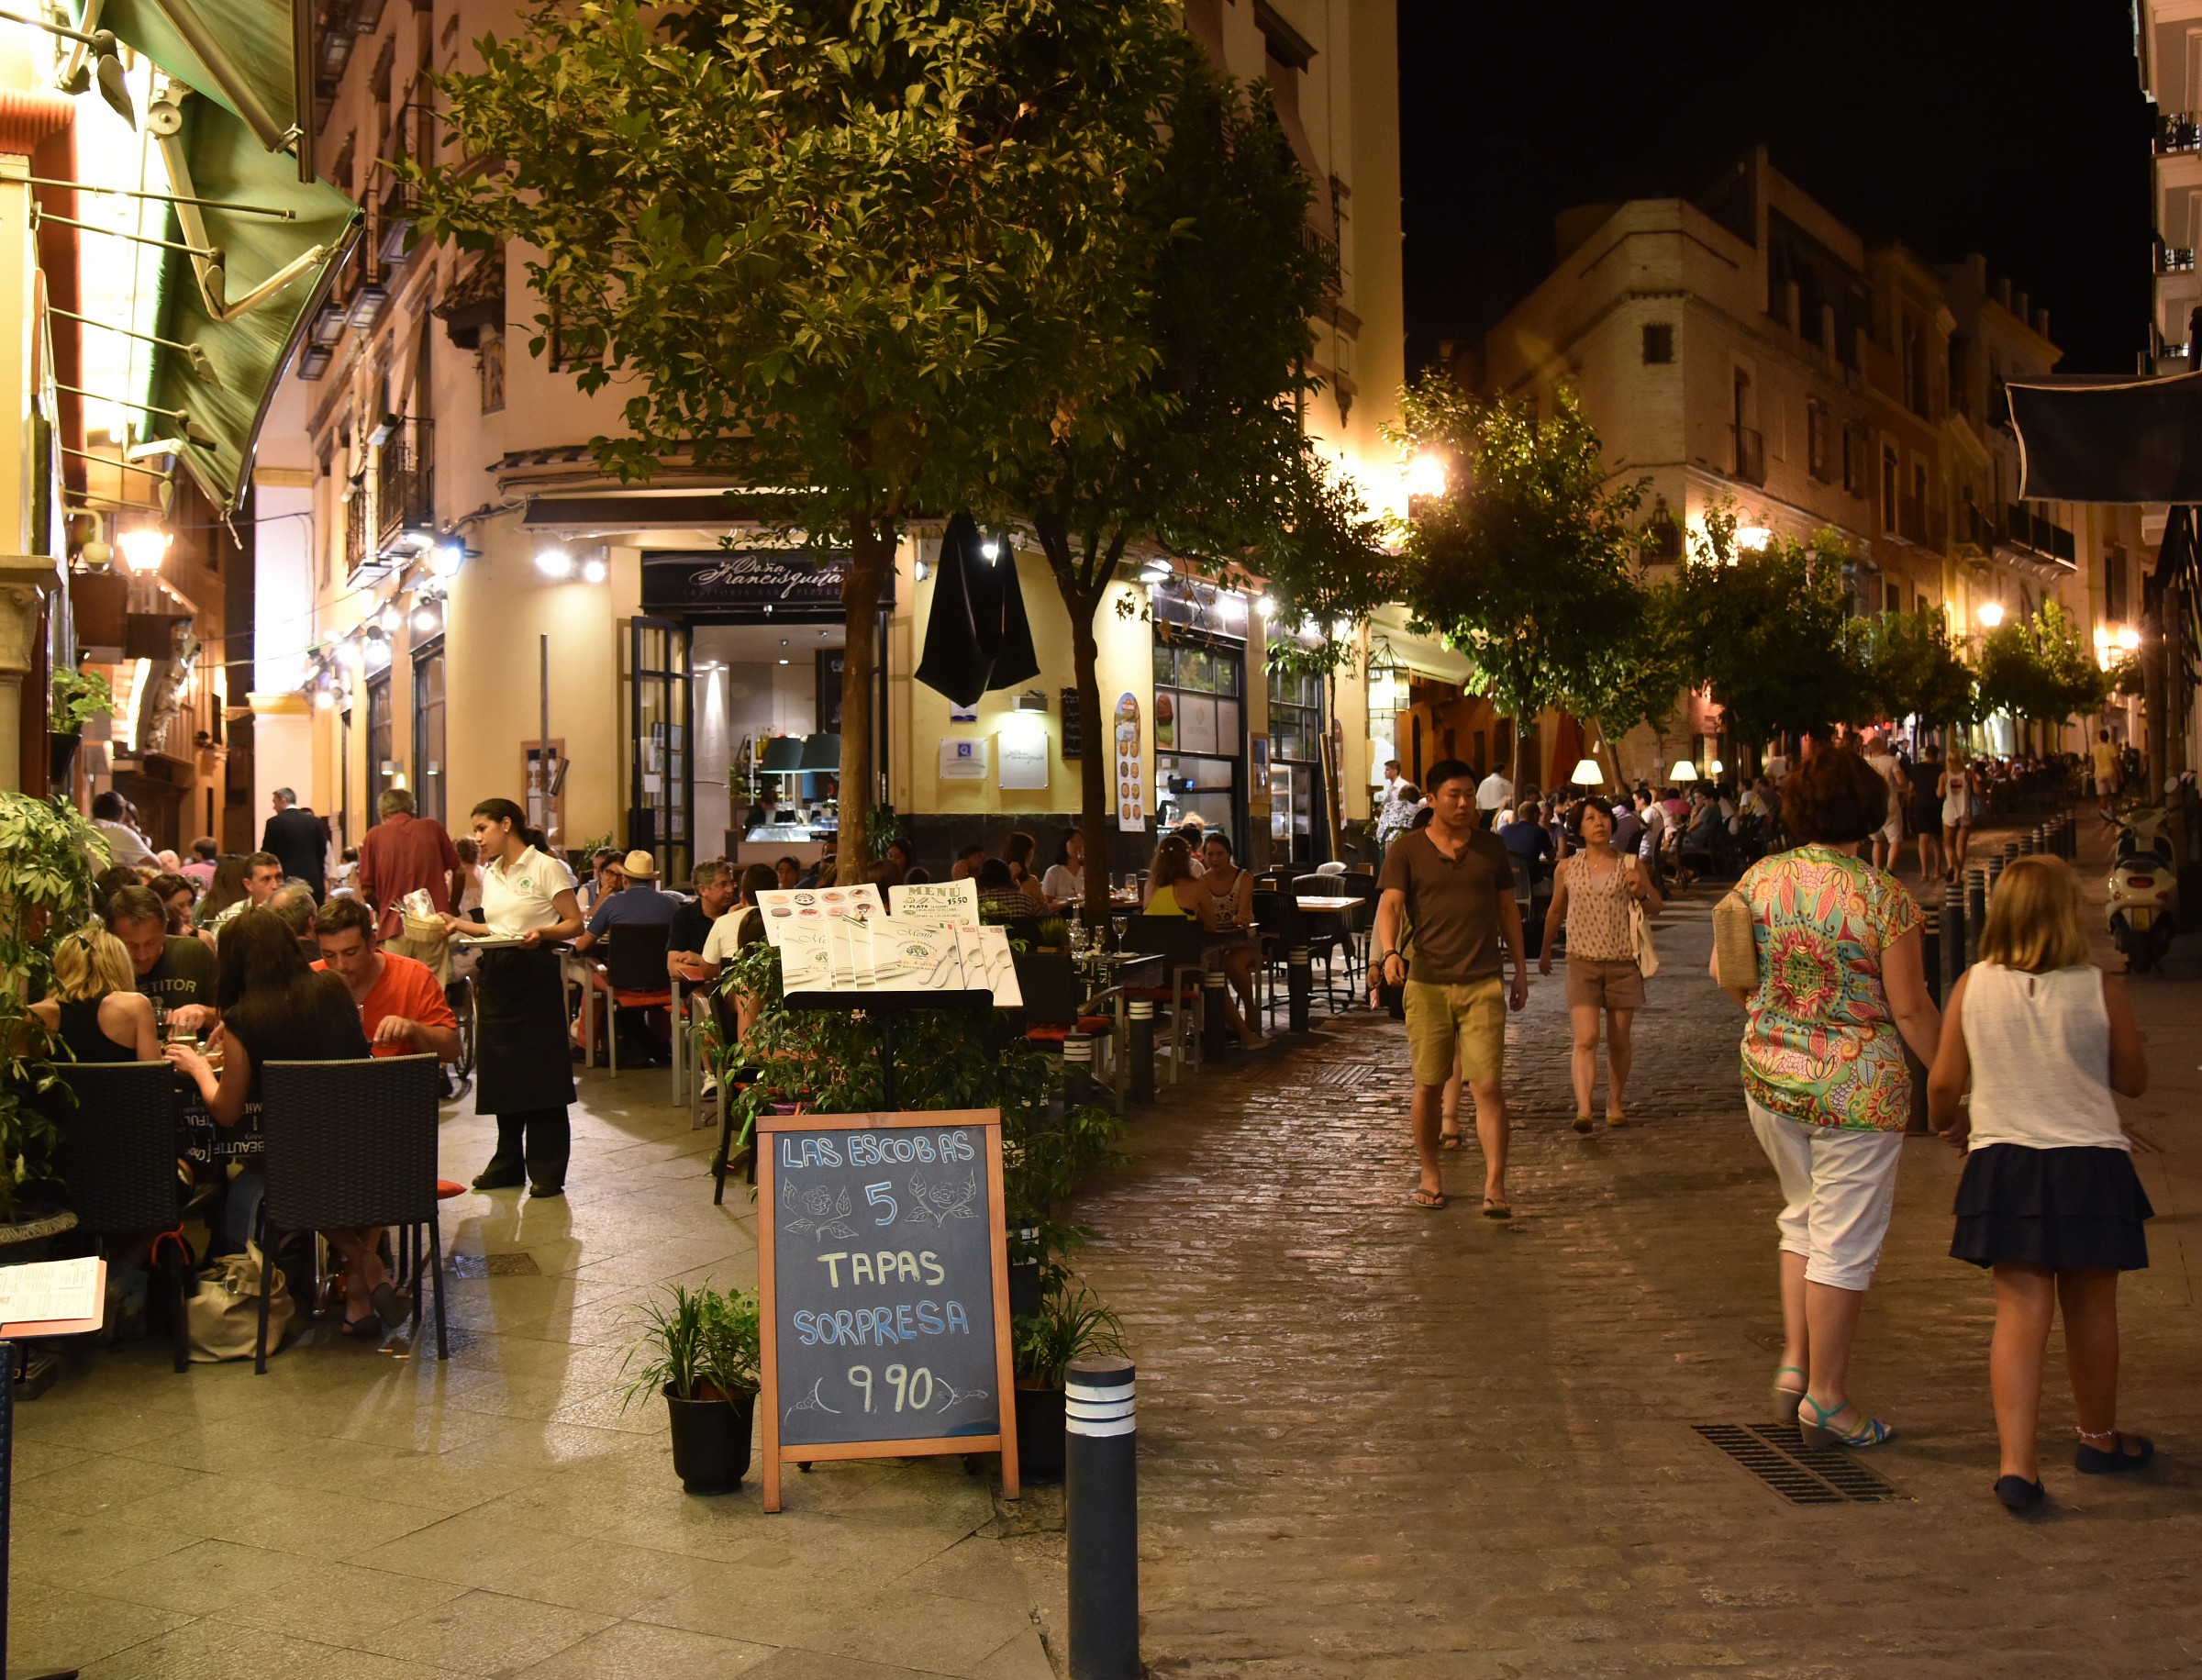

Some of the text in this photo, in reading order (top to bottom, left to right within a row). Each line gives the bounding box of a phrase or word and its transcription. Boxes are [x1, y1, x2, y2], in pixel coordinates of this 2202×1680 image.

[689, 561, 845, 599] Francisquita
[729, 554, 785, 574] Doña
[906, 884, 961, 897] MENÚ
[783, 1129, 975, 1168] LAS ESCOBAS
[864, 1181, 897, 1226] 5
[817, 1250, 945, 1288] TAPAS
[793, 1299, 970, 1347] SORPRESA
